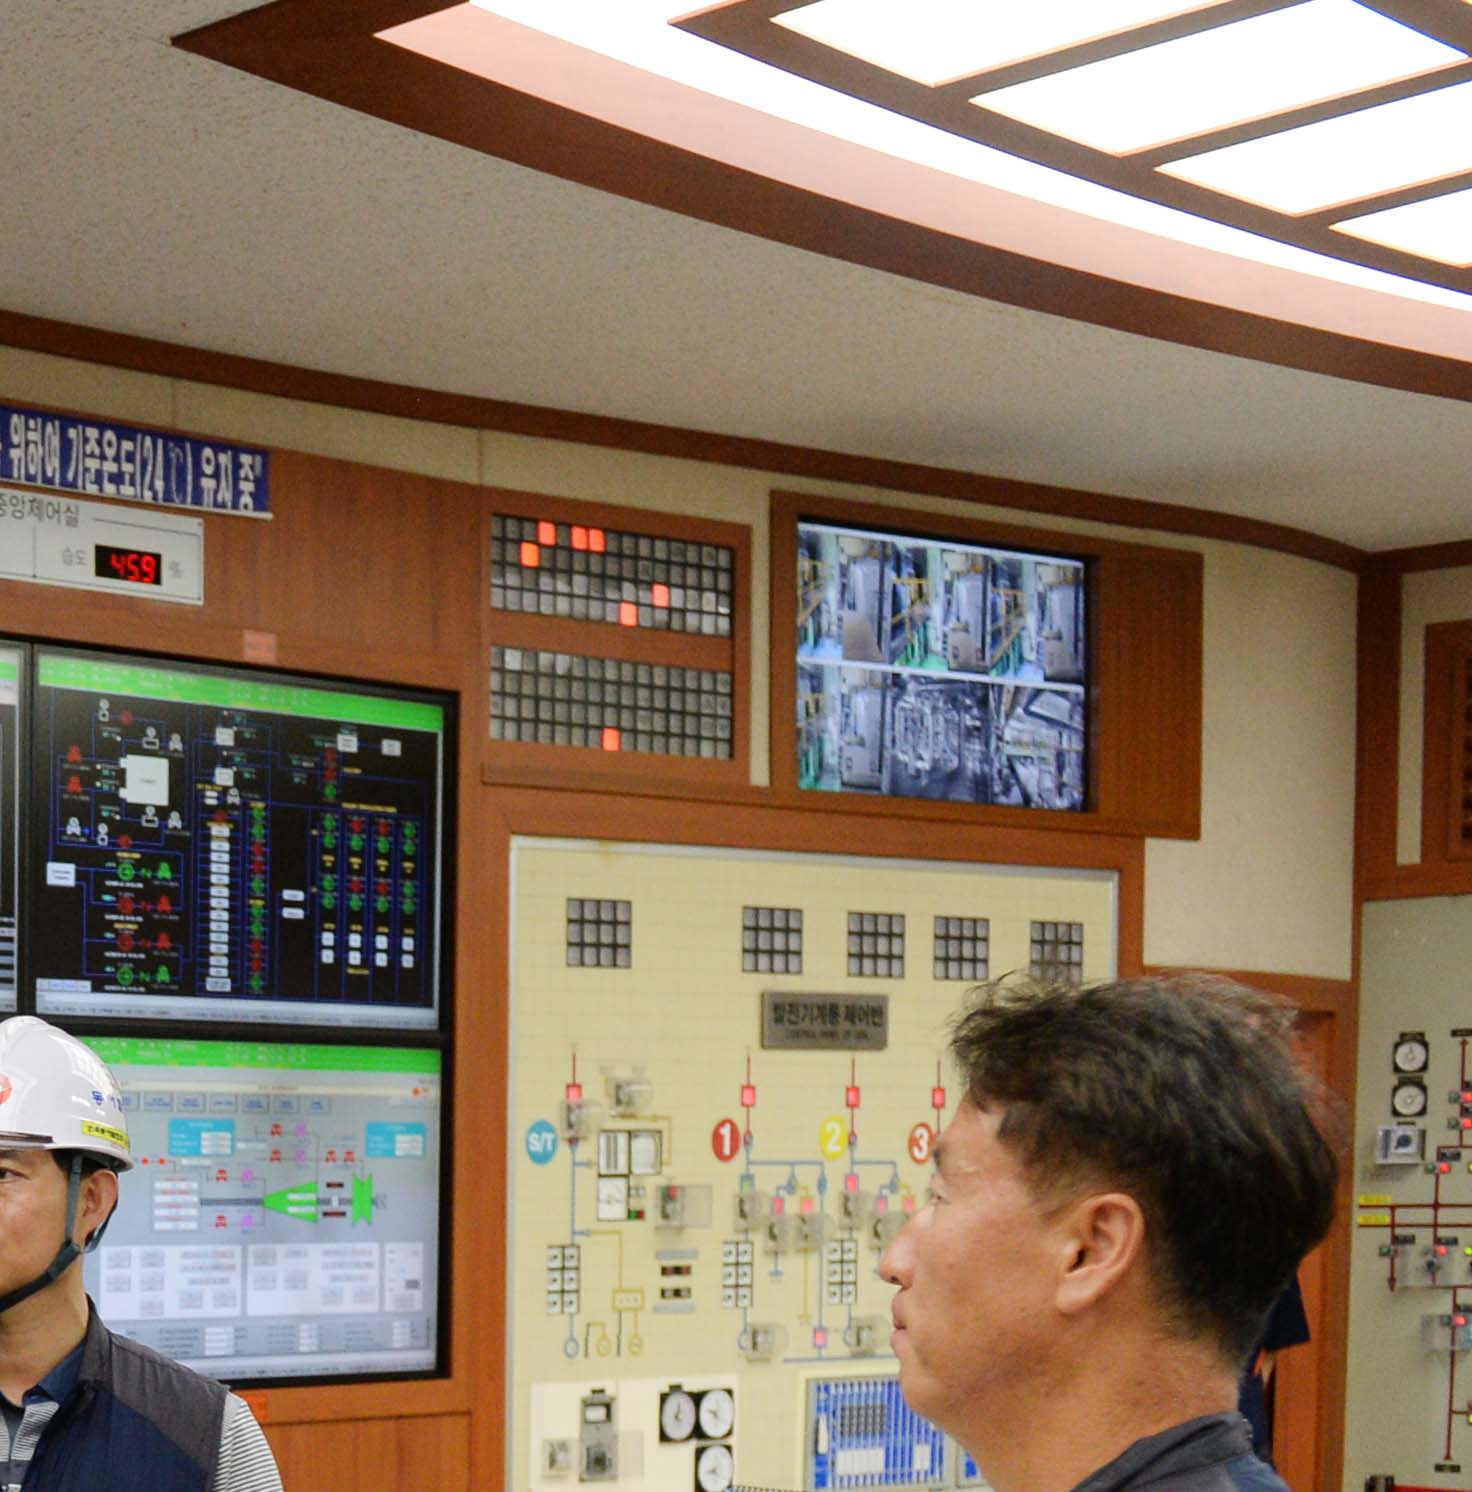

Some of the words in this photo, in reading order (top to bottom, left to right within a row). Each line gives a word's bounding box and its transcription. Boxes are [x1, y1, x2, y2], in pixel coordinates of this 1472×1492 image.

[10, 413, 61, 489] 위하여
[200, 459, 233, 505] 유지
[62, 545, 86, 567] 습도
[527, 1129, 556, 1154] S/T
[717, 1121, 733, 1156] 1
[824, 1120, 842, 1154] 2
[912, 1126, 929, 1159] 3
